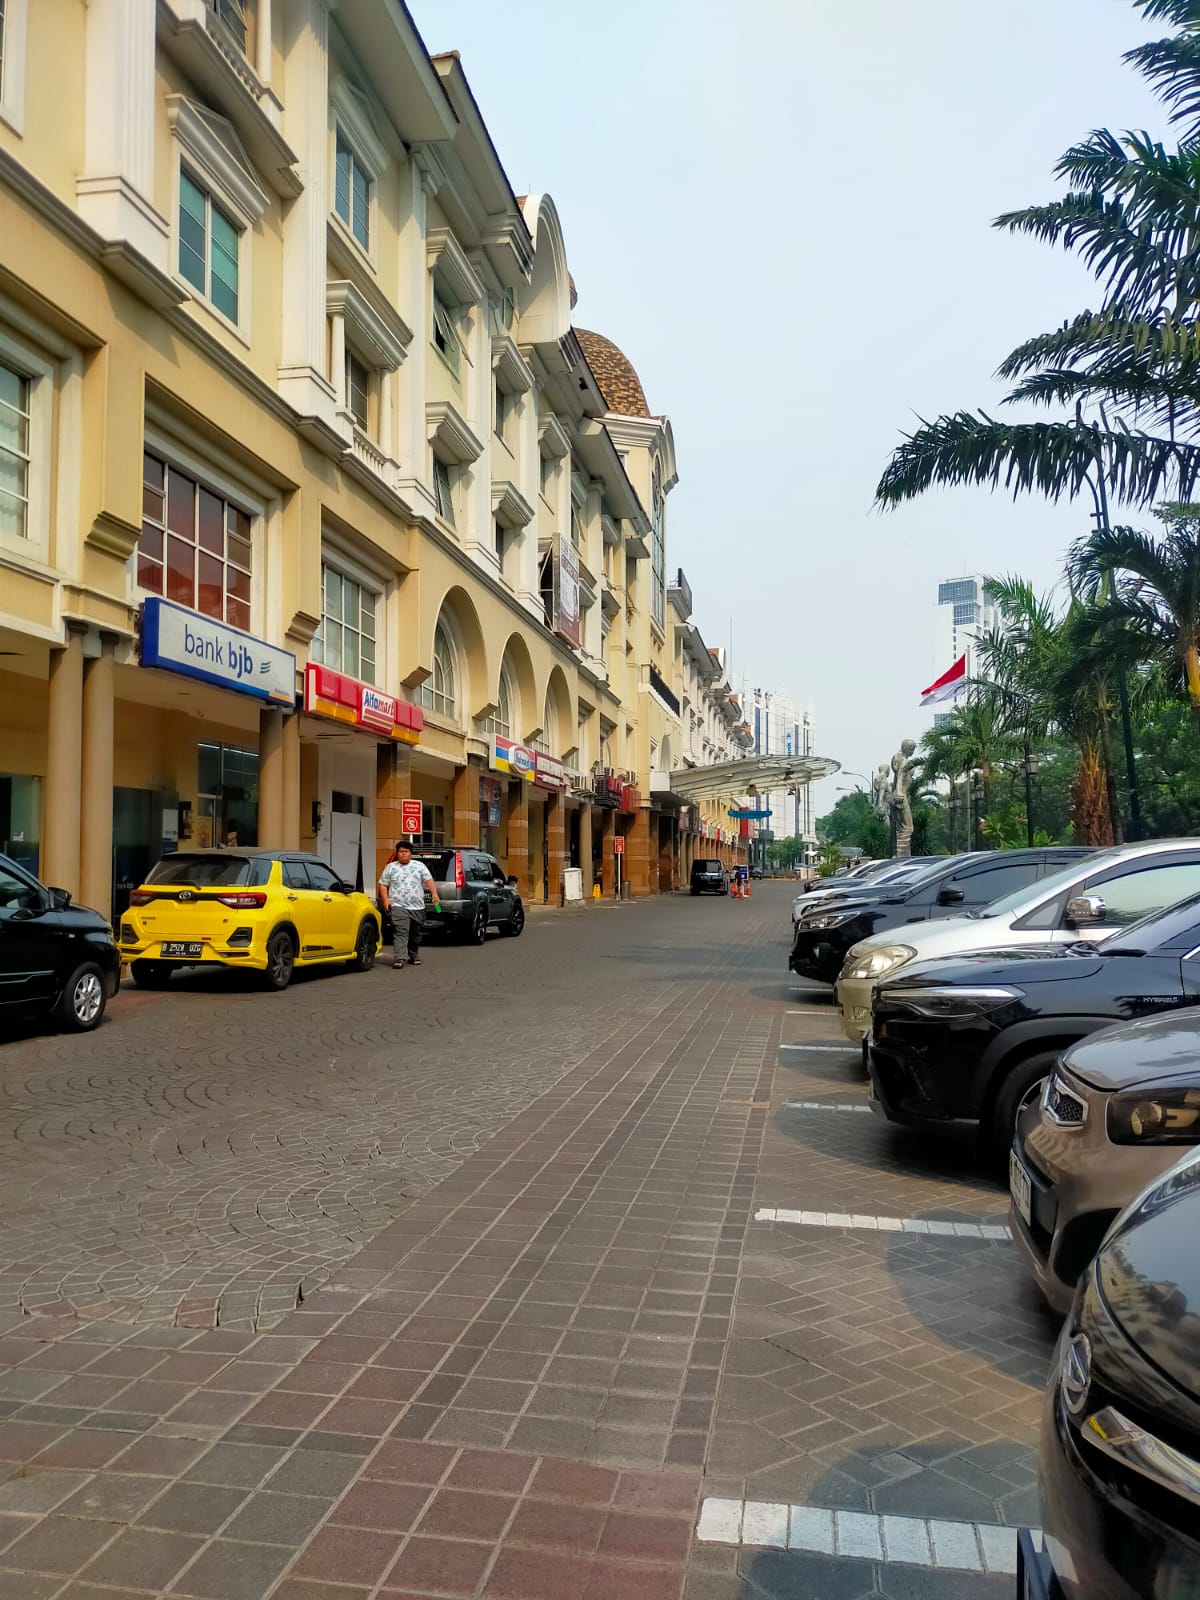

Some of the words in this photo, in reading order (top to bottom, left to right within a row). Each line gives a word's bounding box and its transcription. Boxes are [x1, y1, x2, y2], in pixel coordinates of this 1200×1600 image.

[184, 623, 223, 665] bank
[228, 641, 253, 678] bjb
[364, 690, 394, 716] Alfamart
[408, 819, 416, 829] S
